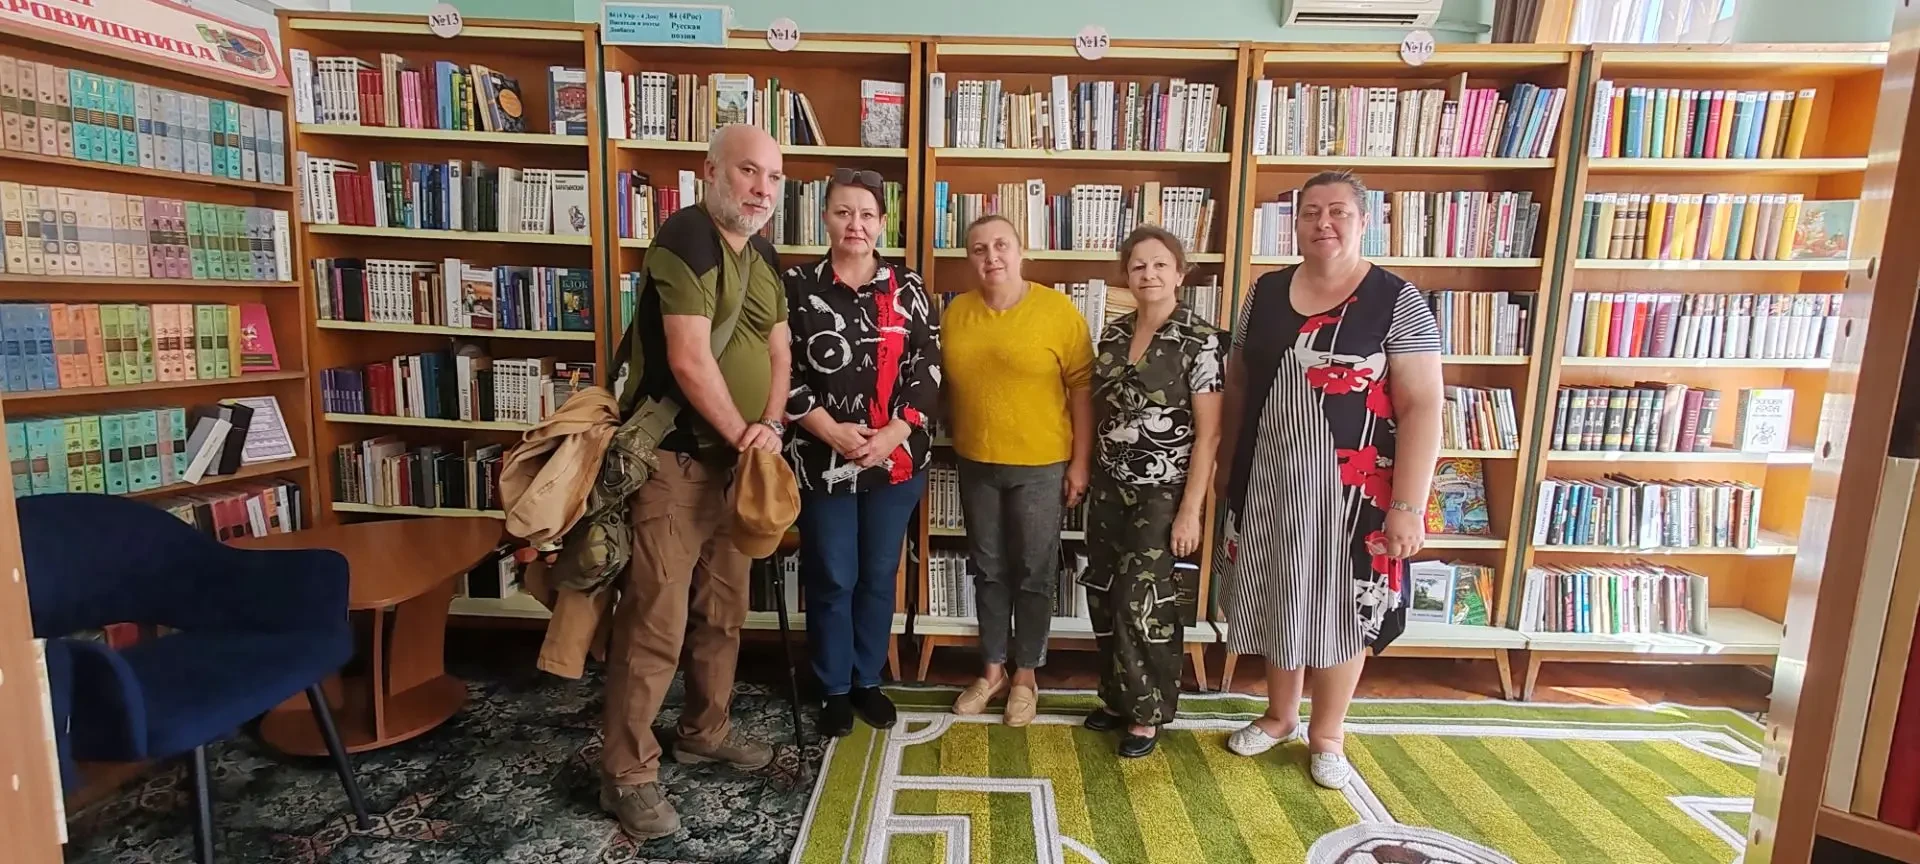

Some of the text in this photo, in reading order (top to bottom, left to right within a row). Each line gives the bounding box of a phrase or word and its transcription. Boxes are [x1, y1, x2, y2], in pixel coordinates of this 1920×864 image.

[430, 14, 460, 27] №13
[680, 12, 702, 21] (4Рос)
[0, 0, 217, 61] РОВИЩНИЦА
[768, 28, 798, 40] №14
[1076, 36, 1108, 48] №15
[1402, 41, 1432, 54] №16
[450, 166, 459, 178] Б
[1029, 183, 1040, 196] С
[529, 366, 539, 377] В
